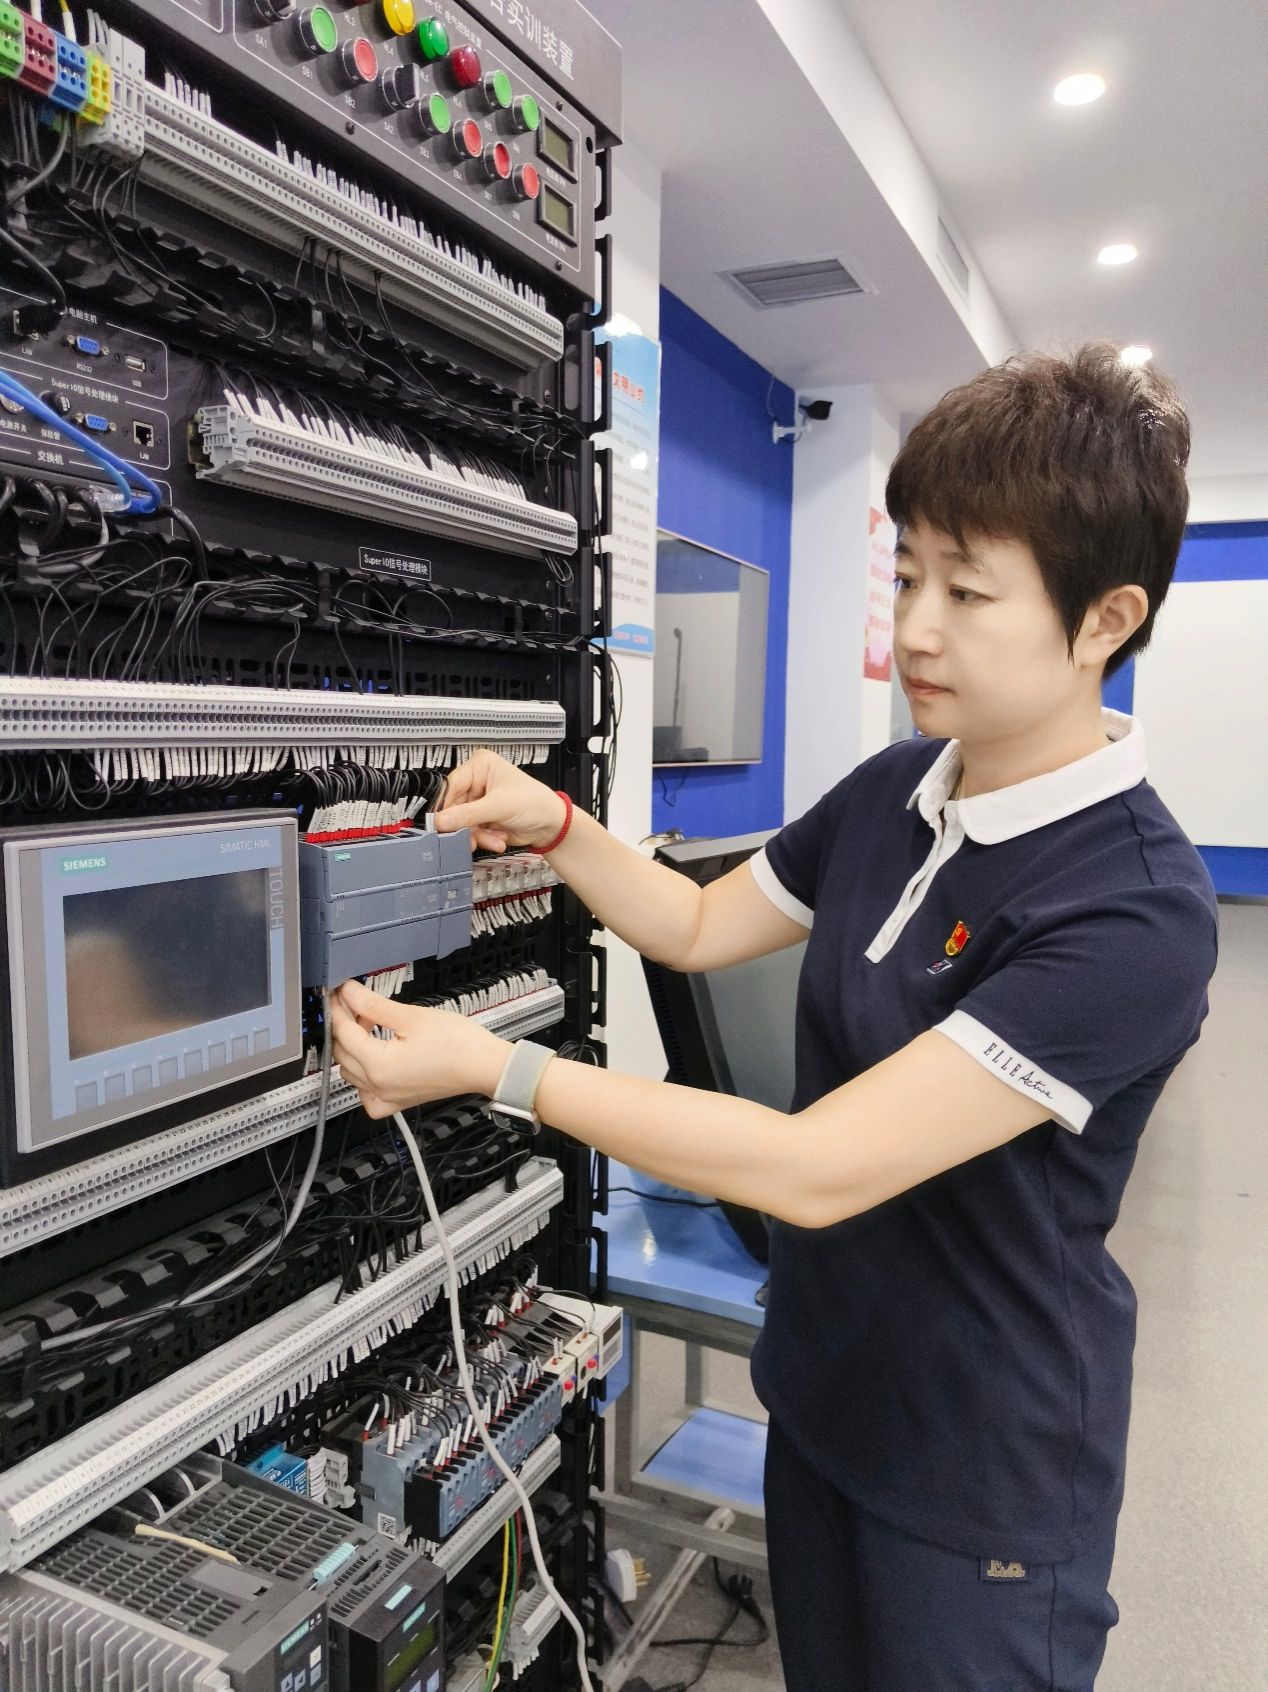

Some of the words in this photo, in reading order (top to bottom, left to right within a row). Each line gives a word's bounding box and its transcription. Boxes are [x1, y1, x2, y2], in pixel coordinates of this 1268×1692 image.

[220, 841, 253, 854] SIMATIC
[254, 839, 270, 849] HMI
[63, 857, 107, 871] SIEMENS
[270, 867, 284, 929] TOUCH
[983, 1042, 1022, 1077] ELLE
